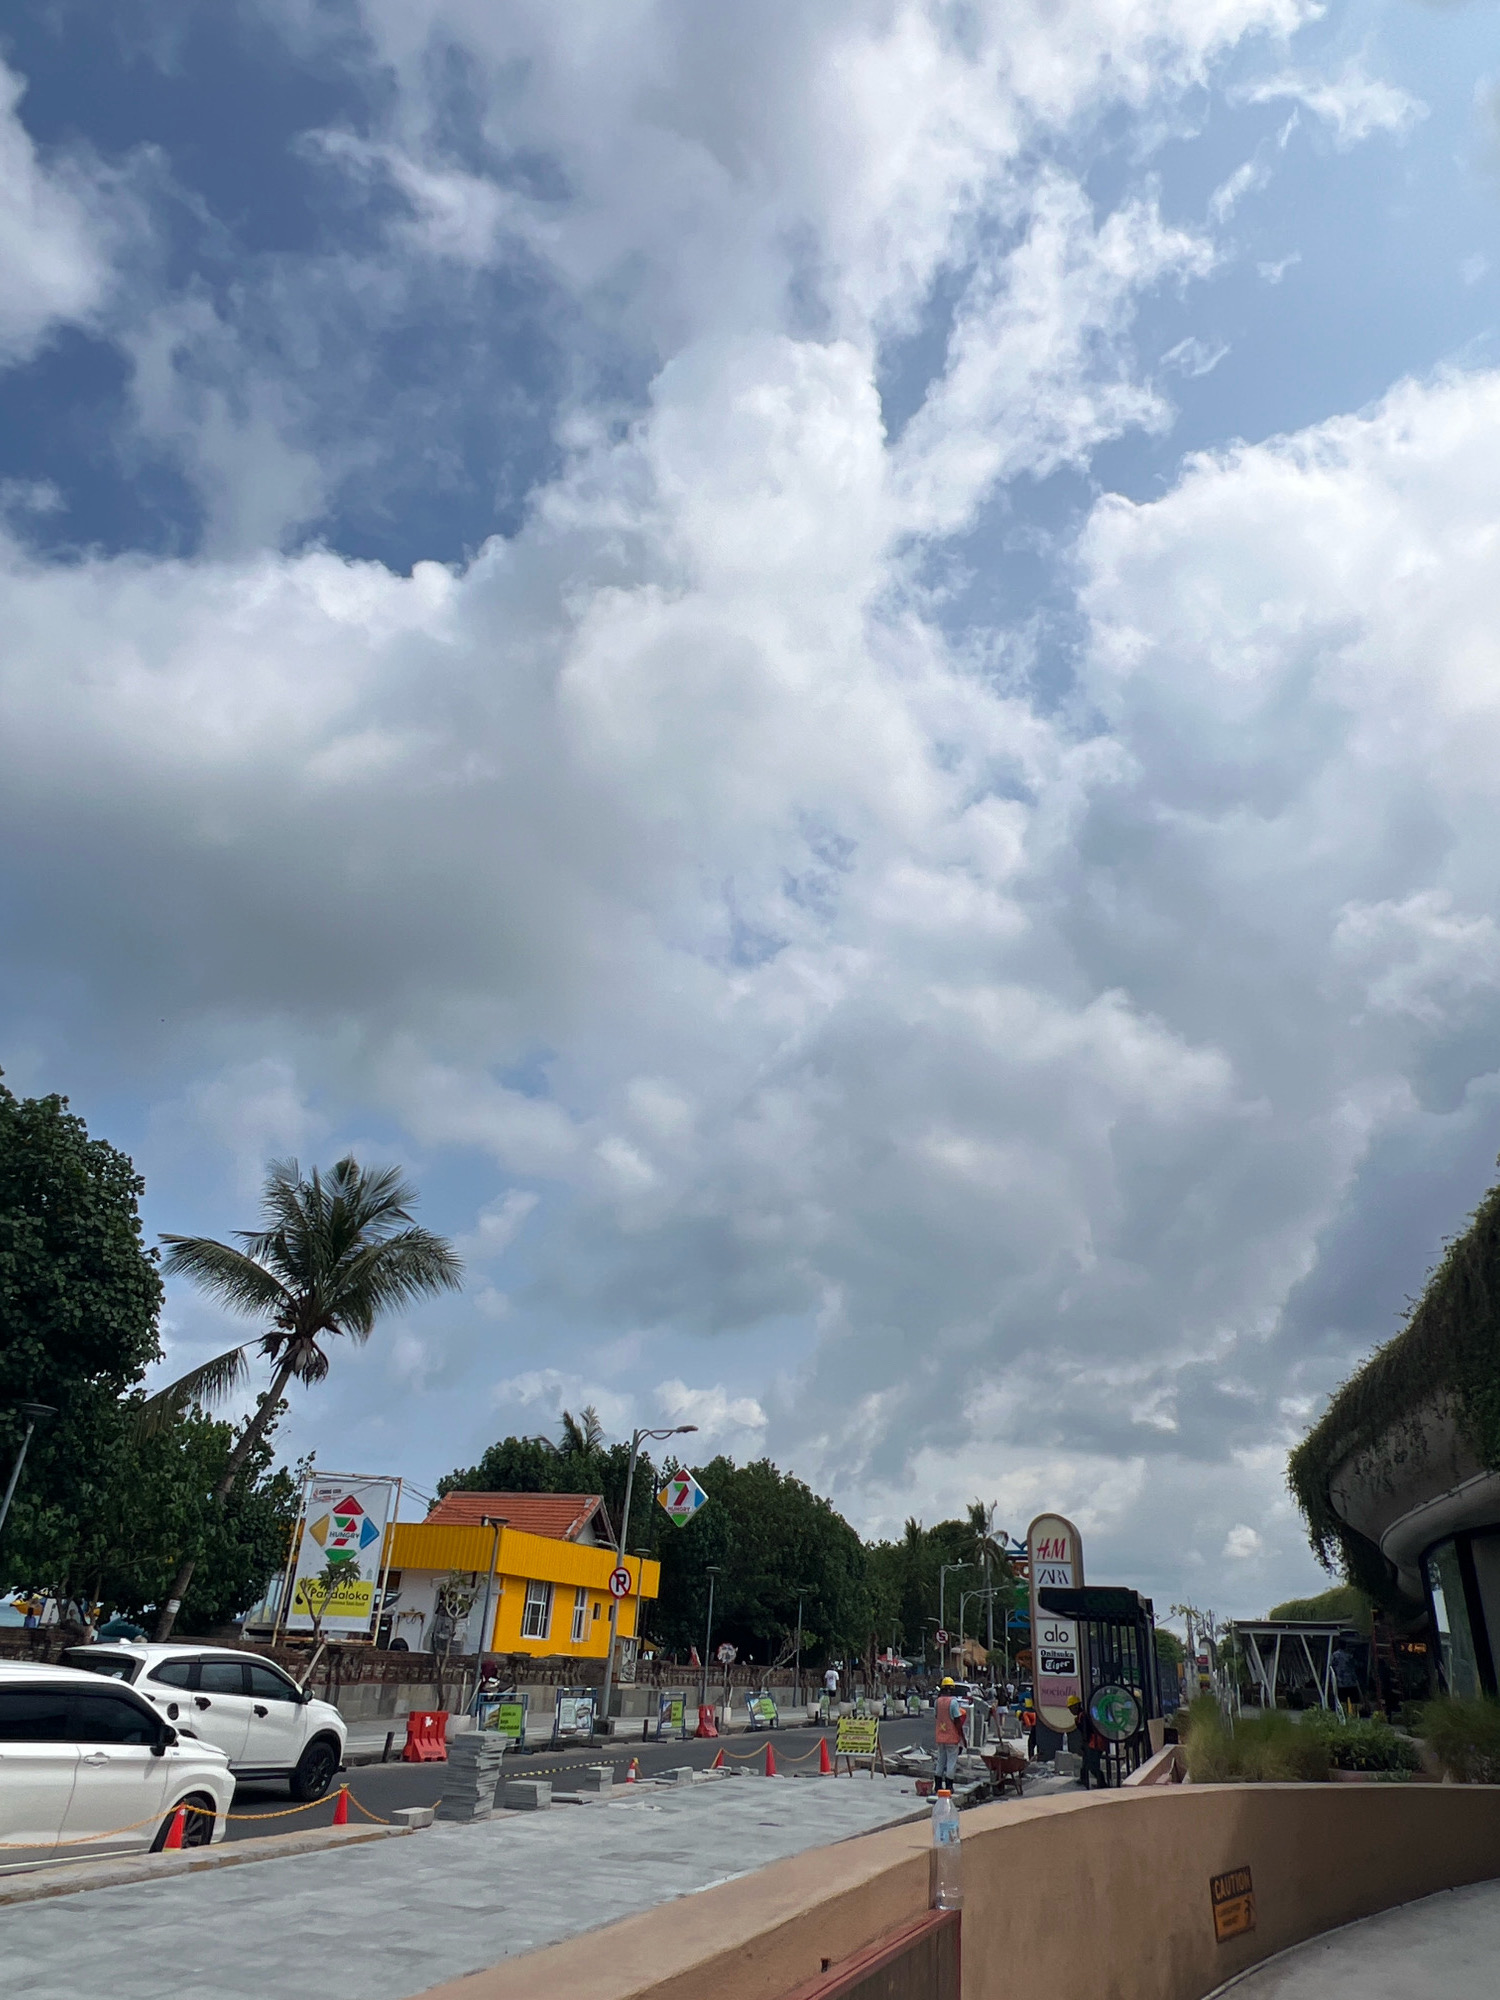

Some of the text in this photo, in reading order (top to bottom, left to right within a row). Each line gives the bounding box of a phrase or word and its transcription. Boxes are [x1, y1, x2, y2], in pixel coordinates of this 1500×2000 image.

[329, 1531, 360, 1539] HUNGRY
[1036, 1538, 1066, 1560] H&M
[615, 1573, 627, 1592] P
[1037, 1568, 1069, 1584] ZARA
[1044, 1624, 1069, 1642] alo
[1040, 1650, 1074, 1658] Onitsuka
[1045, 1659, 1071, 1670] Tiger
[1041, 1686, 1076, 1697] sociolla
[1214, 1871, 1251, 1900] CAUTION
